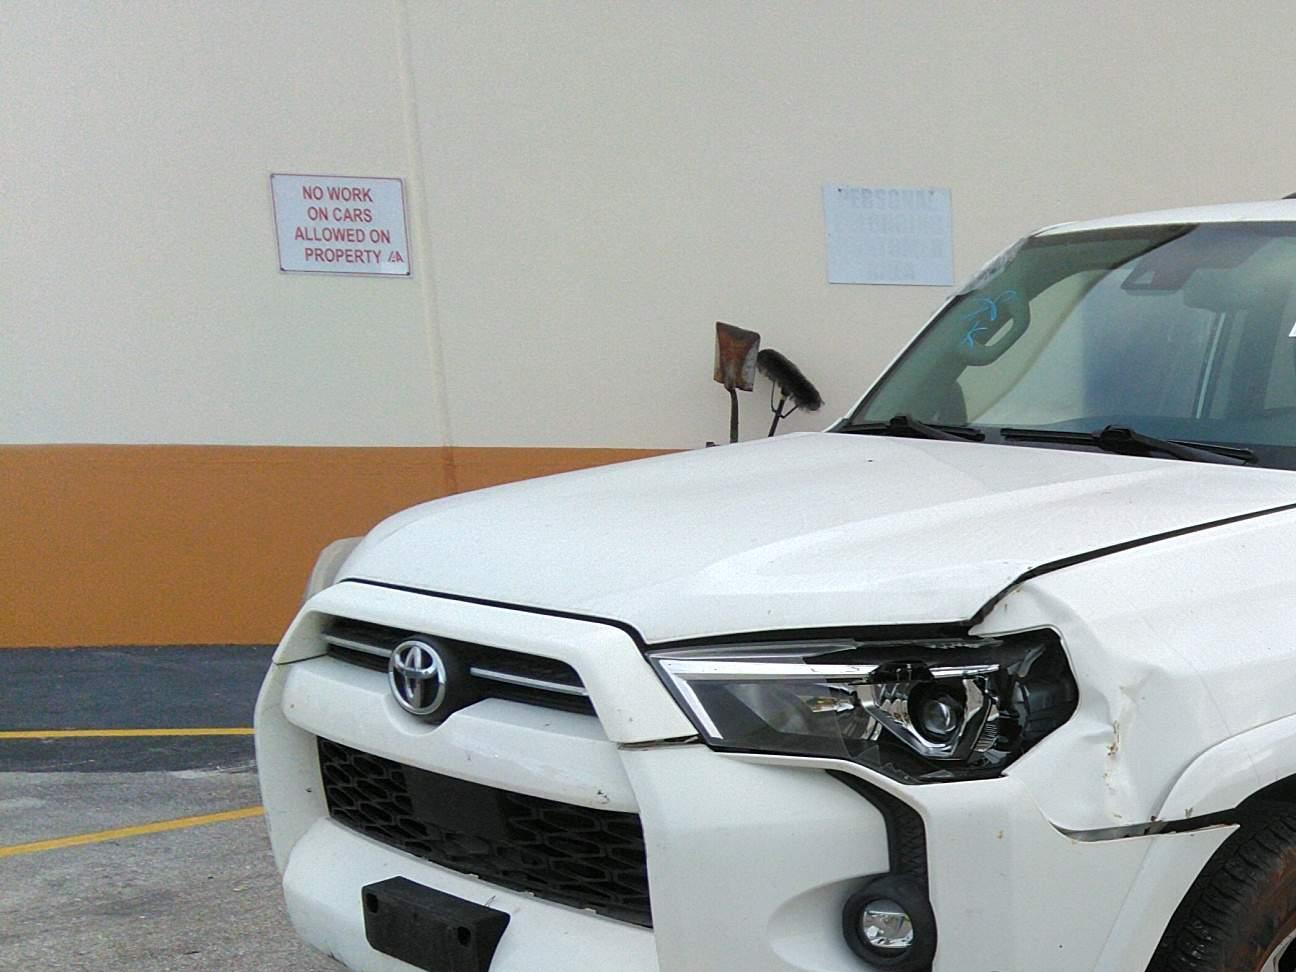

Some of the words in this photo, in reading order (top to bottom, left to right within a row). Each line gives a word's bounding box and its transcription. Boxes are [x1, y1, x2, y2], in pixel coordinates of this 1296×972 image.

[302, 185, 324, 201] NO
[327, 186, 373, 203] WORK
[307, 206, 329, 221] ON
[333, 207, 373, 223] CARS
[294, 227, 365, 243] ALLOWED
[369, 229, 391, 244] ON
[304, 247, 382, 264] PROPERTY
